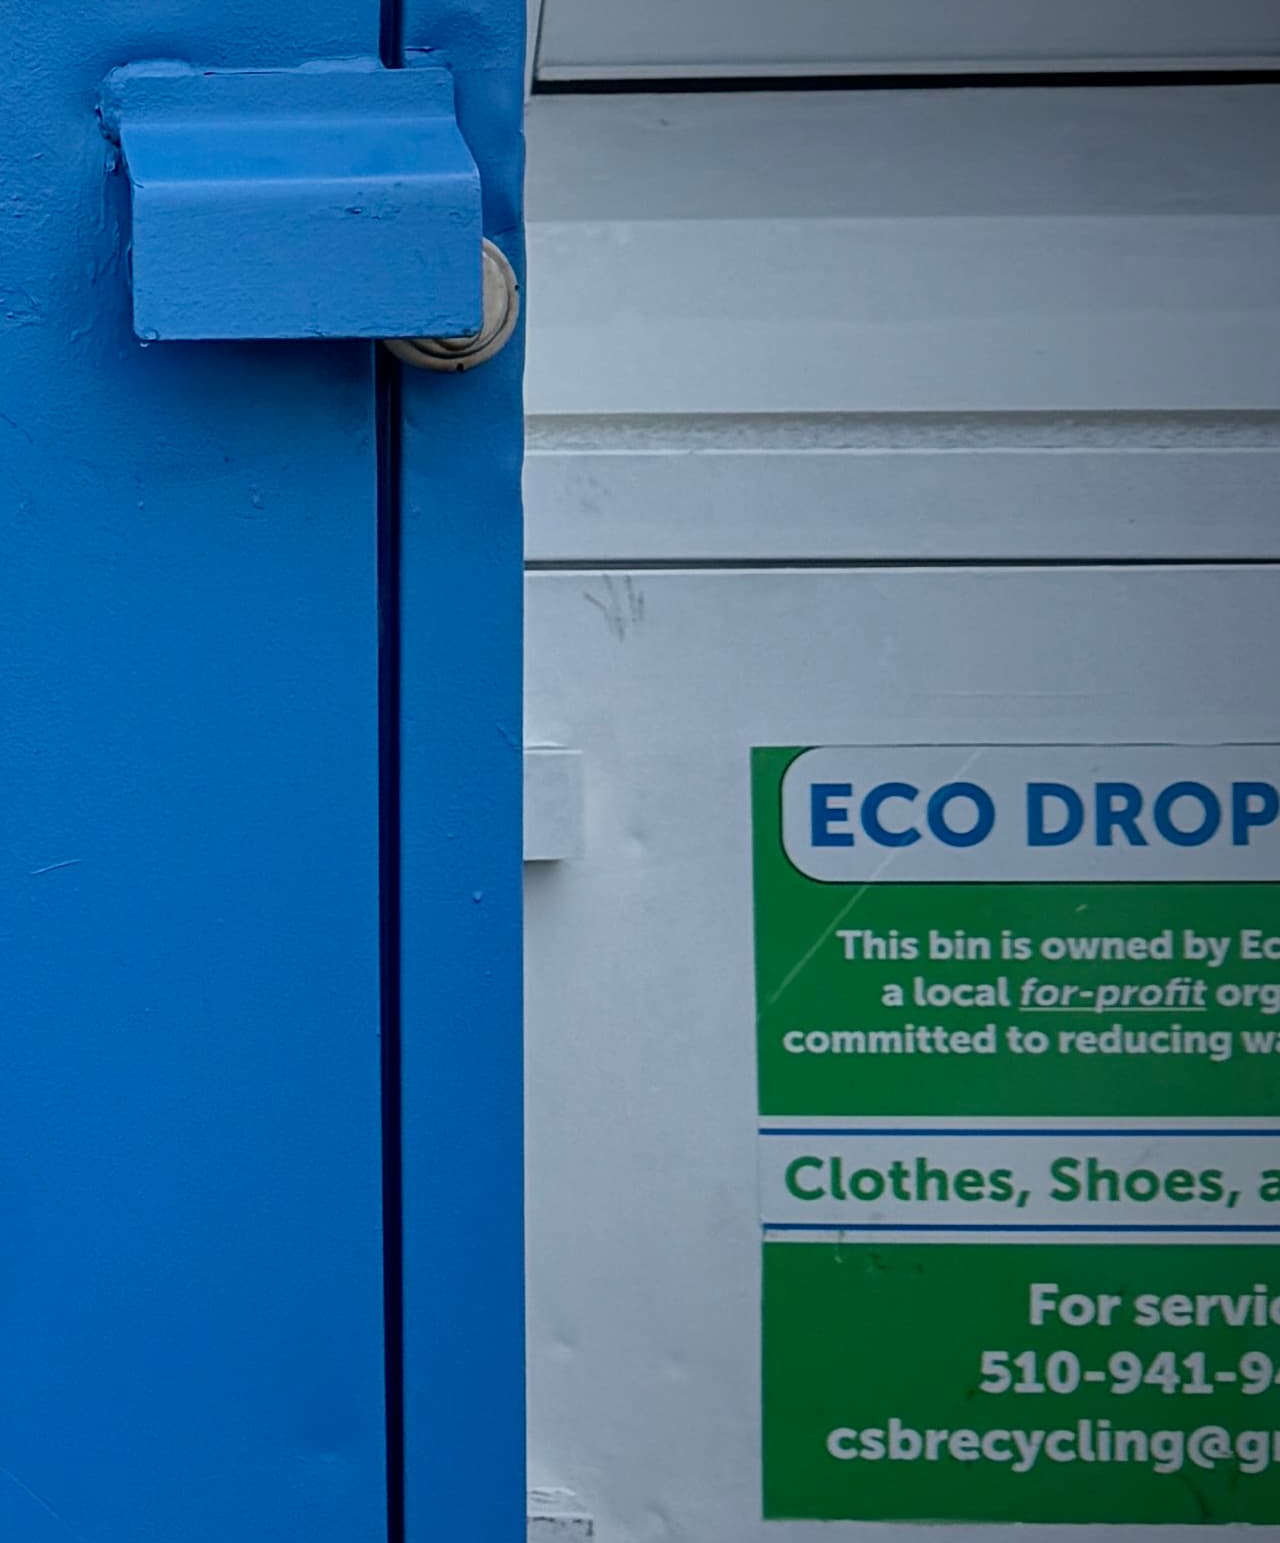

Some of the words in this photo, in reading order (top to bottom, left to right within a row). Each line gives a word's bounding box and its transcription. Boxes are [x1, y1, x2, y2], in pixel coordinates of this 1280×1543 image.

[809, 781, 997, 849] ECO
[1025, 780, 1280, 849] DROP
[835, 929, 920, 961] This
[928, 929, 992, 962] bin
[1000, 929, 1033, 962] is
[1038, 929, 1174, 962] owned
[1182, 929, 1231, 968] by
[1239, 929, 1280, 961] Ec
[880, 982, 905, 1008] a
[912, 976, 1012, 1008] local
[1018, 976, 1209, 1014] for-profit
[1214, 982, 1280, 1016] org
[781, 1023, 998, 1055] committed
[1004, 1025, 1051, 1055] to
[1057, 1023, 1233, 1062] reducing
[783, 1155, 1032, 1209] Clothes,
[1048, 1156, 1242, 1210] Shoes,
[1028, 1282, 1123, 1327] For
[978, 1349, 1280, 1397] 510-941-9
[825, 1416, 1280, 1475] csbrecycling@g
